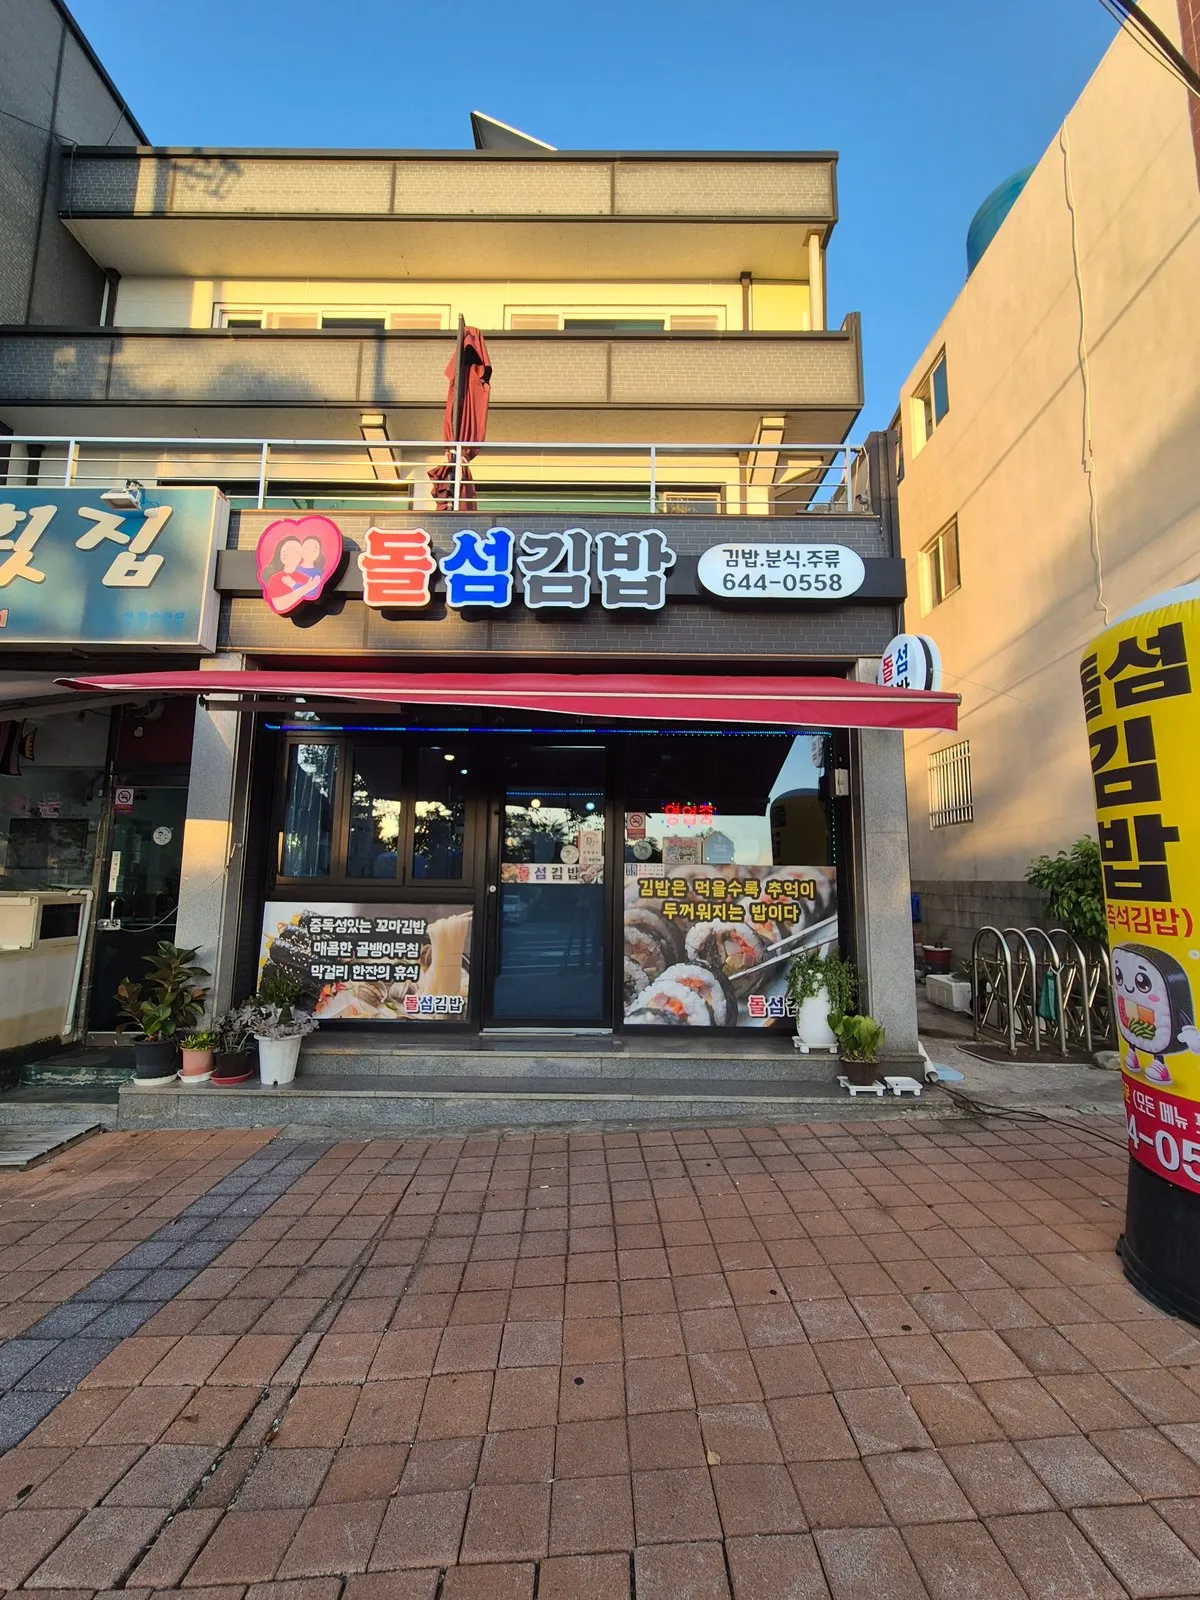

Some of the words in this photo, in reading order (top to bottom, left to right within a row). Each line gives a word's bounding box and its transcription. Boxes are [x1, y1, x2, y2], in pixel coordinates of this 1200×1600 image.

[357, 526, 677, 611] 돌섬김밥
[722, 571, 842, 594] 644-0558
[639, 879, 687, 898] 김밥은
[695, 879, 760, 898] 먹을수록
[767, 881, 815, 899] 추억이
[663, 903, 744, 921] 두꺼워지는
[752, 905, 799, 922] 밥이다
[309, 918, 372, 934] 중독성있는
[375, 919, 426, 935] 꼬마김밥
[313, 941, 352, 956] 매콤한
[356, 941, 419, 958] 골뱅이무침
[311, 964, 348, 980] 막걸리
[352, 965, 389, 980] 한잔의
[393, 965, 419, 981] 휴식
[404, 994, 465, 1014] 돌섬김밥
[1159, 1101, 1188, 1131] 메뉴
